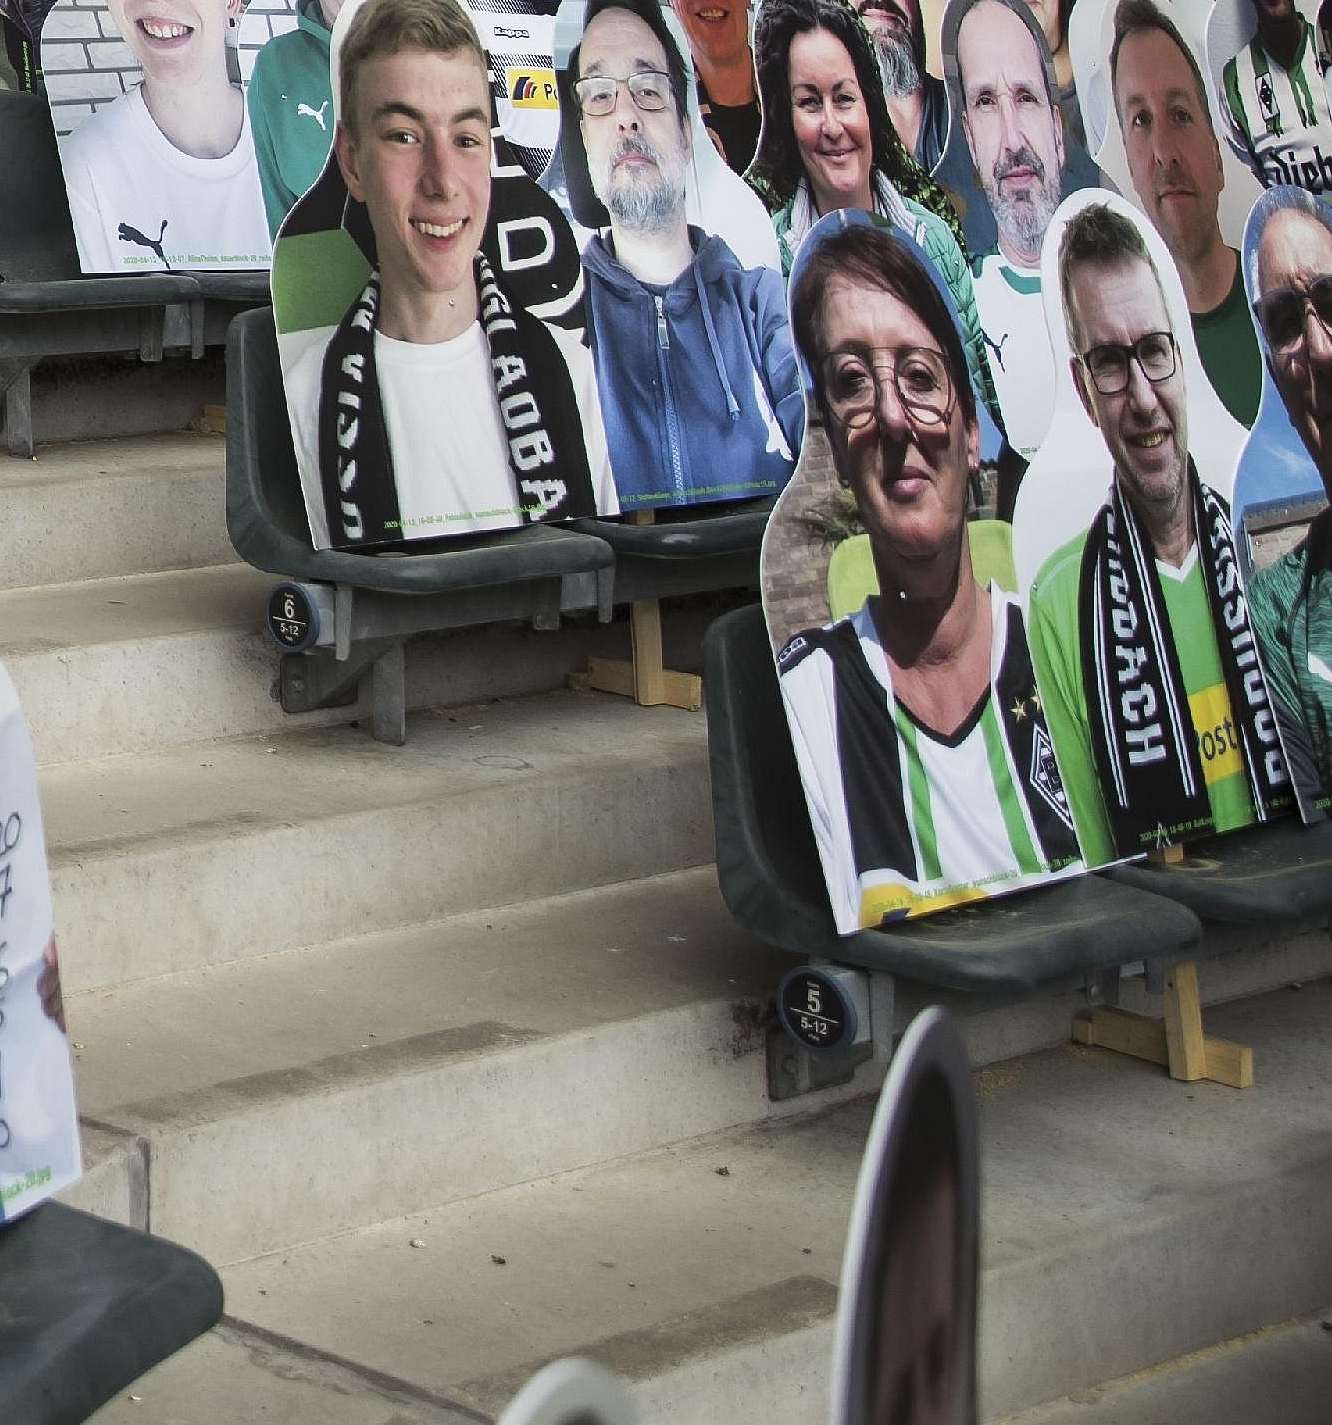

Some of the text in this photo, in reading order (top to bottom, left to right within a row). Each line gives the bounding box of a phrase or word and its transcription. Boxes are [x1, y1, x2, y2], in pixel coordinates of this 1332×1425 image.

[494, 26, 530, 39] Kappa
[284, 599, 295, 619] 6
[279, 623, 299, 636] 5-12
[1198, 717, 1239, 762] ost
[807, 989, 821, 1013] 5
[800, 1016, 828, 1035] 5-12
